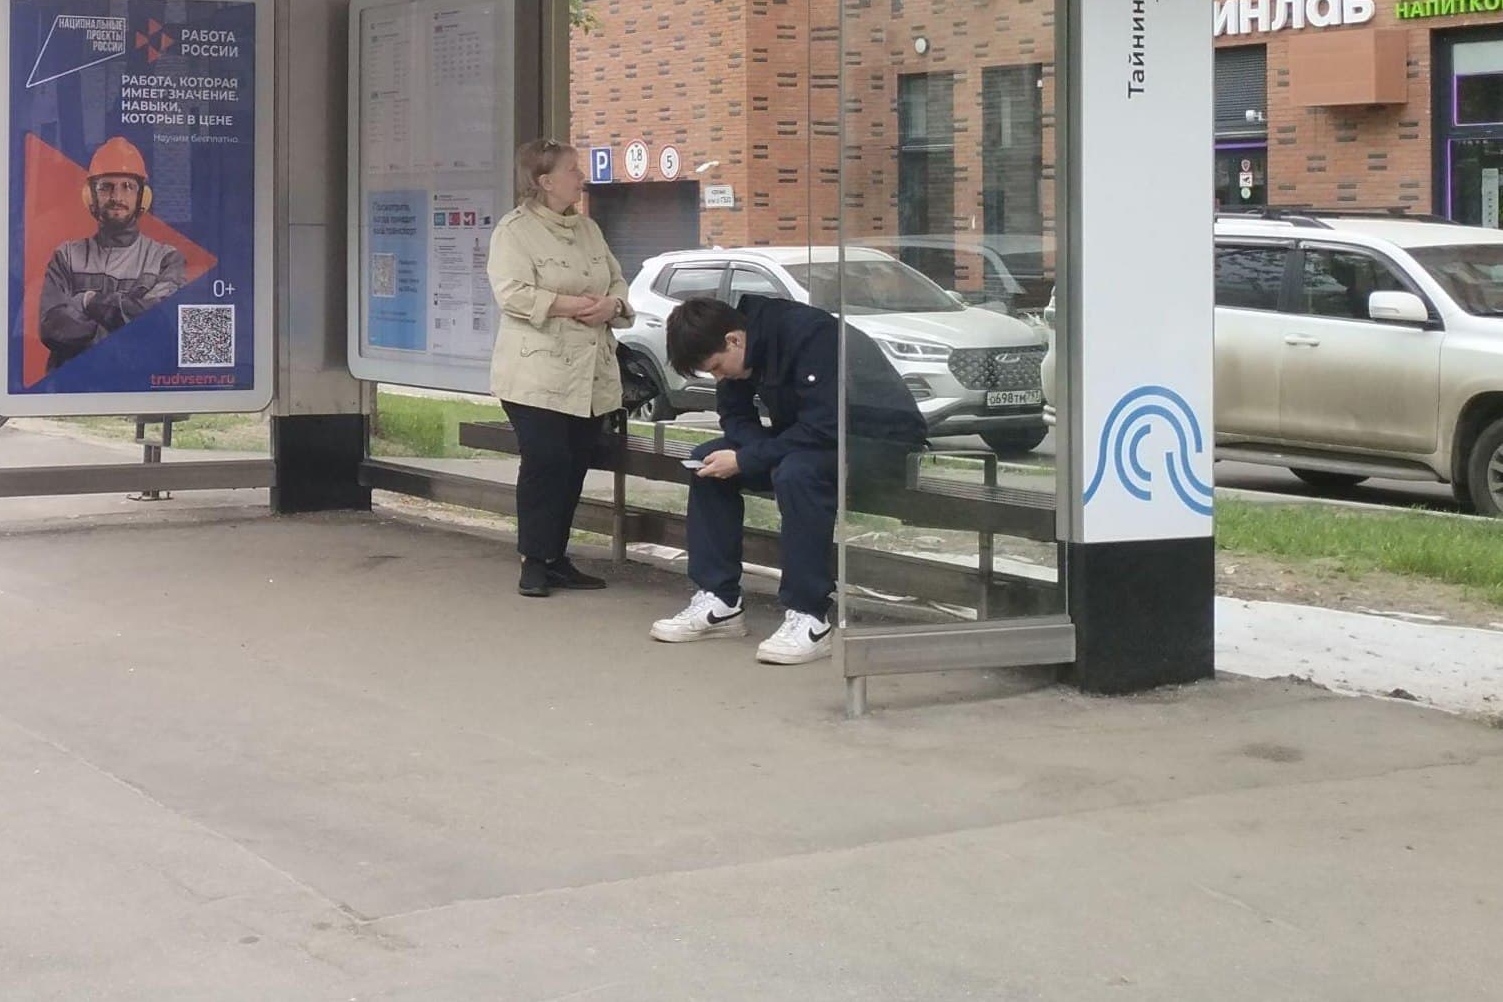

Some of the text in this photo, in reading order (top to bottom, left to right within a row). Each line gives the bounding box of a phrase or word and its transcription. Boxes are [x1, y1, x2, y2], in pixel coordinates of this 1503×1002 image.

[58, 17, 124, 30] НАЦИОНАЛЬНЫЕ
[86, 29, 124, 41] ПРОЕКТЫ
[181, 29, 236, 43] РАБОТА
[92, 40, 124, 52] РОССИИ
[181, 44, 239, 58] РОССИИ
[121, 75, 239, 89] РАБОТА, КОТОРАЯ
[121, 87, 166, 99] ИМЕЕТ
[121, 101, 182, 113] НАВЫКИ,
[121, 114, 234, 127] КОТОРЫЕ В ЦЕНЕ
[152, 133, 189, 144] Научим
[665, 154, 673, 169] 5
[213, 279, 236, 297] 0+
[150, 373, 234, 385] trudvsem.ru
